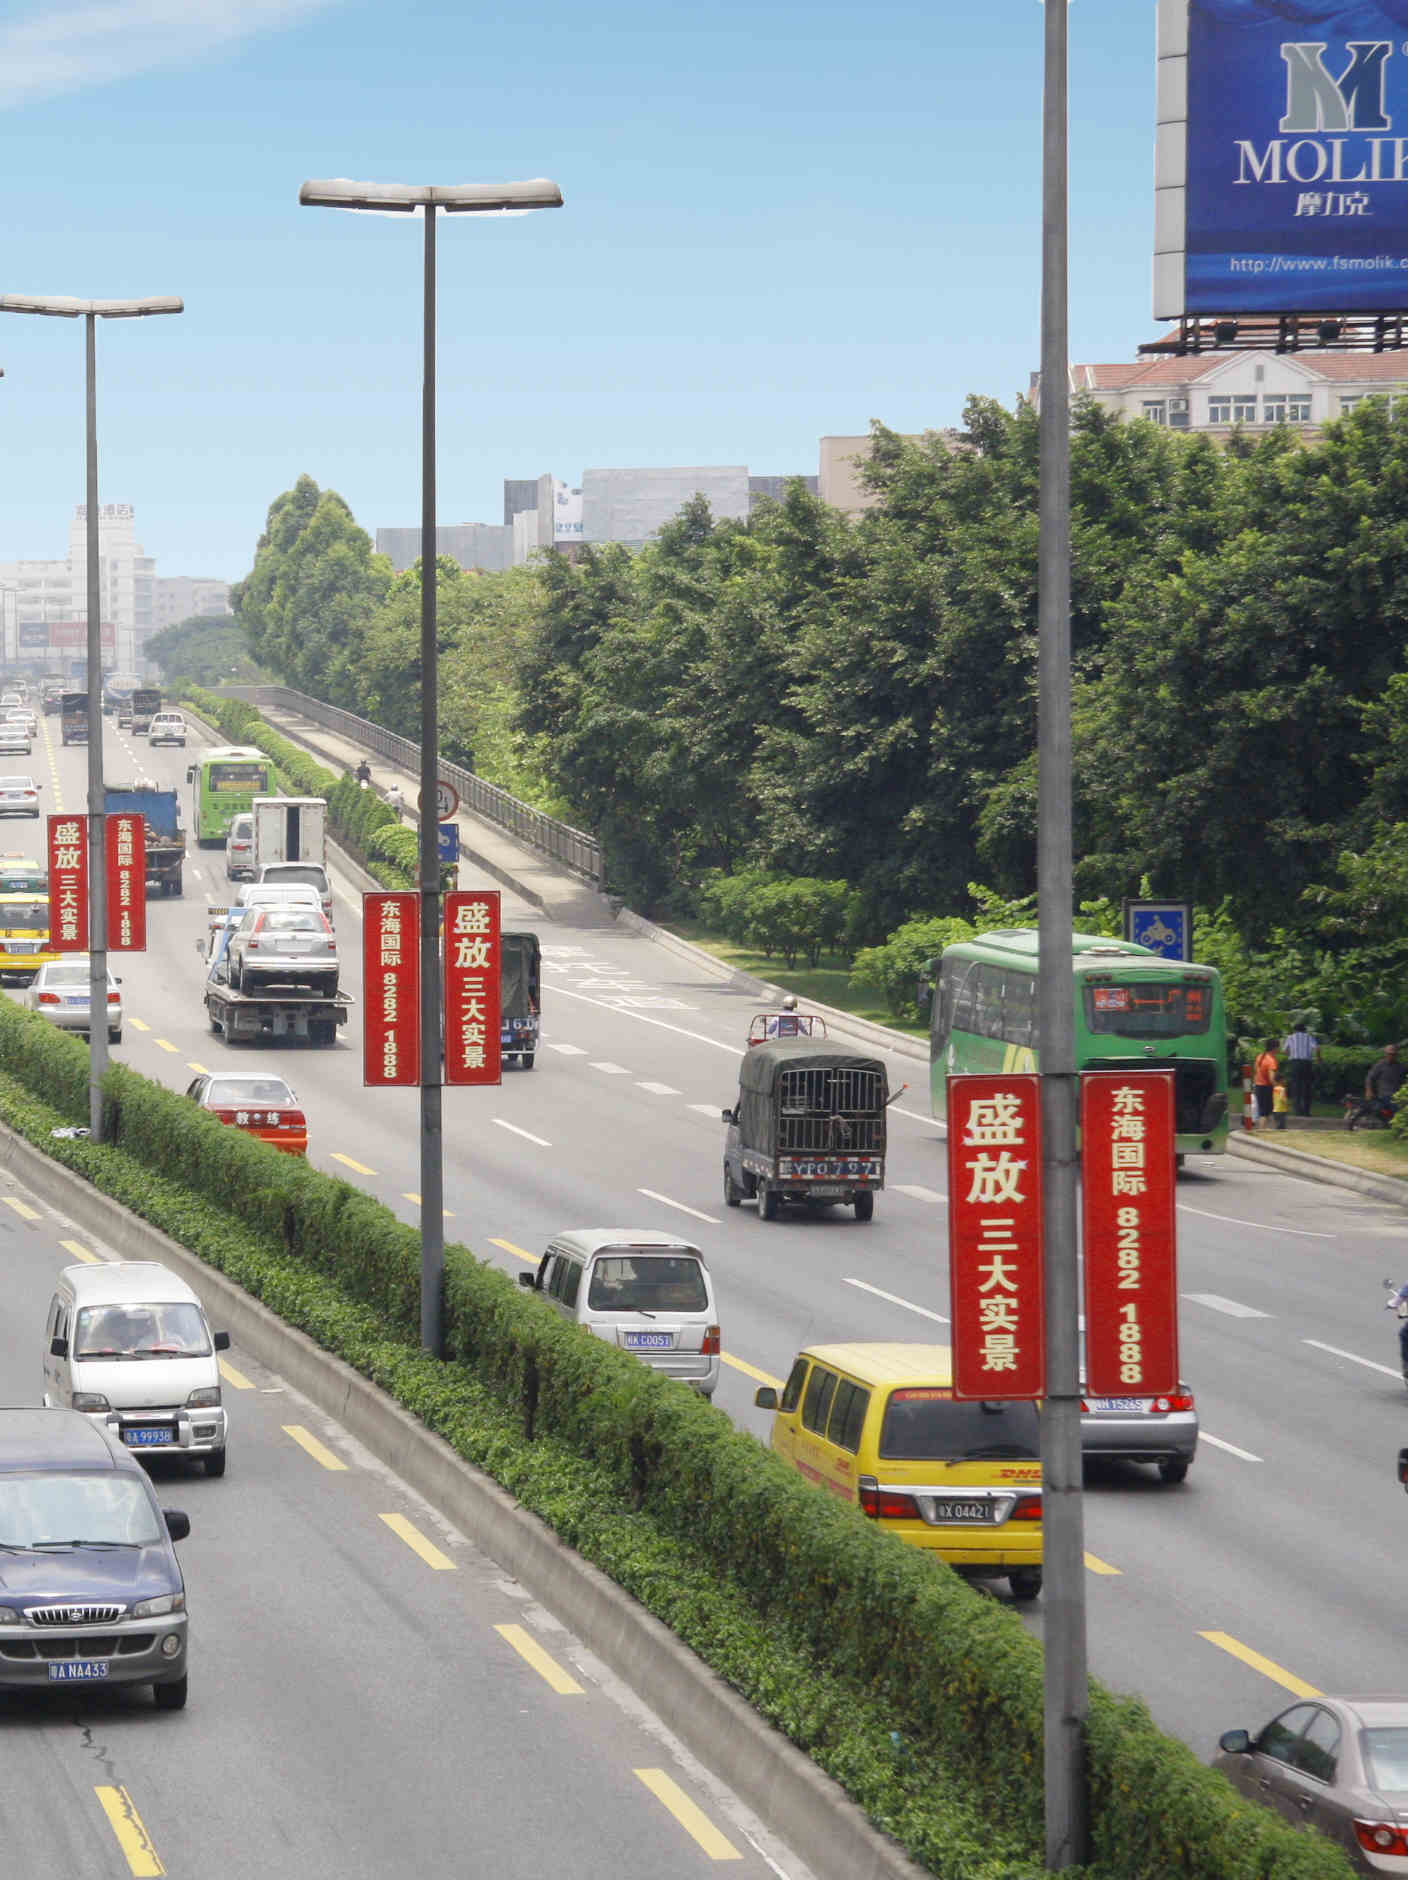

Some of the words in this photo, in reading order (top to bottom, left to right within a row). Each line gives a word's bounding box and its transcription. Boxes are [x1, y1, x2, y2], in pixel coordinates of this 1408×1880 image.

[1294, 191, 1375, 217] 摩力克
[380, 901, 402, 967] 东海国际
[461, 977, 487, 1069] 三大实景
[1110, 1086, 1148, 1196] 东海国际
[1116, 1207, 1141, 1290] 8282
[977, 1218, 1020, 1372] 三大实景
[1118, 1303, 1143, 1385] 1888
